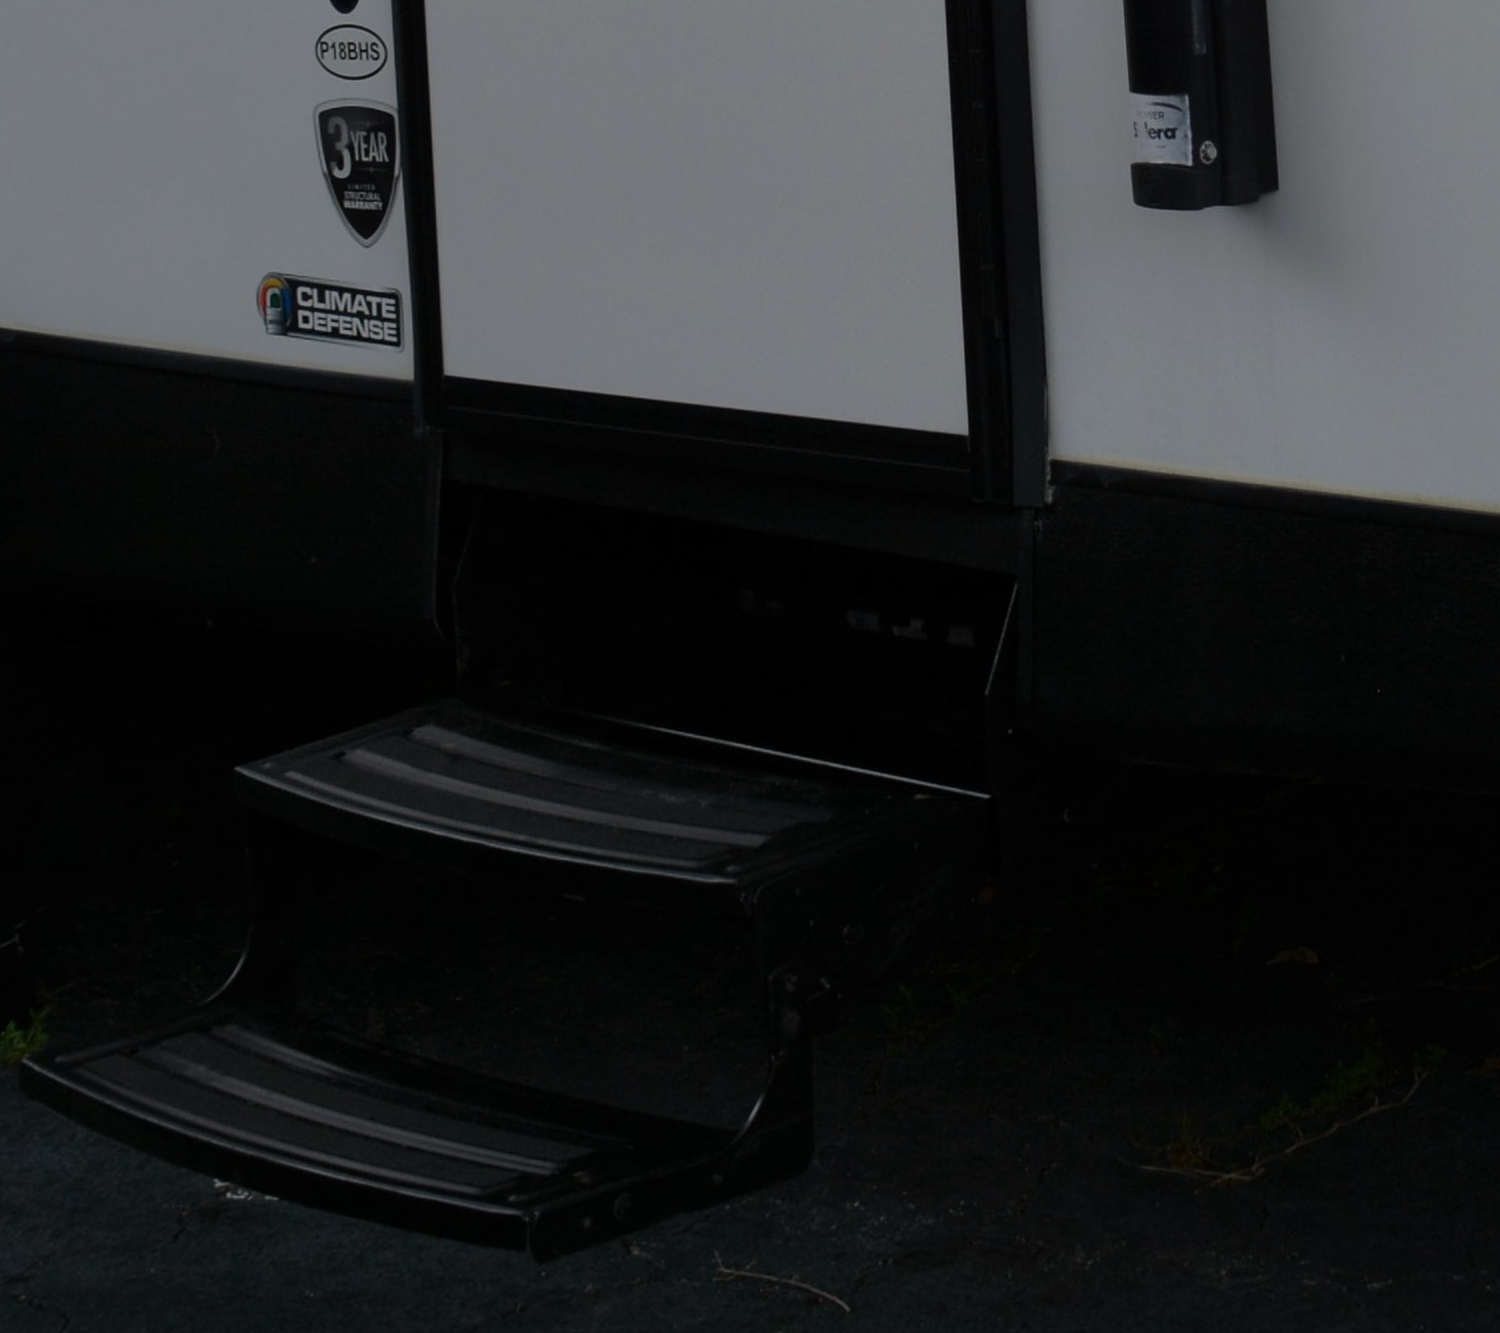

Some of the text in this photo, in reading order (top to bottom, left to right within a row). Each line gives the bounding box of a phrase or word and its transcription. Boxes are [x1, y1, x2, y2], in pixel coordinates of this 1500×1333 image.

[320, 41, 380, 61] P18BHS
[327, 116, 390, 180] 3 YEAR
[343, 199, 384, 211] WARRANTY
[297, 285, 397, 319] CLIMATE
[297, 308, 399, 343] DEFENSE
